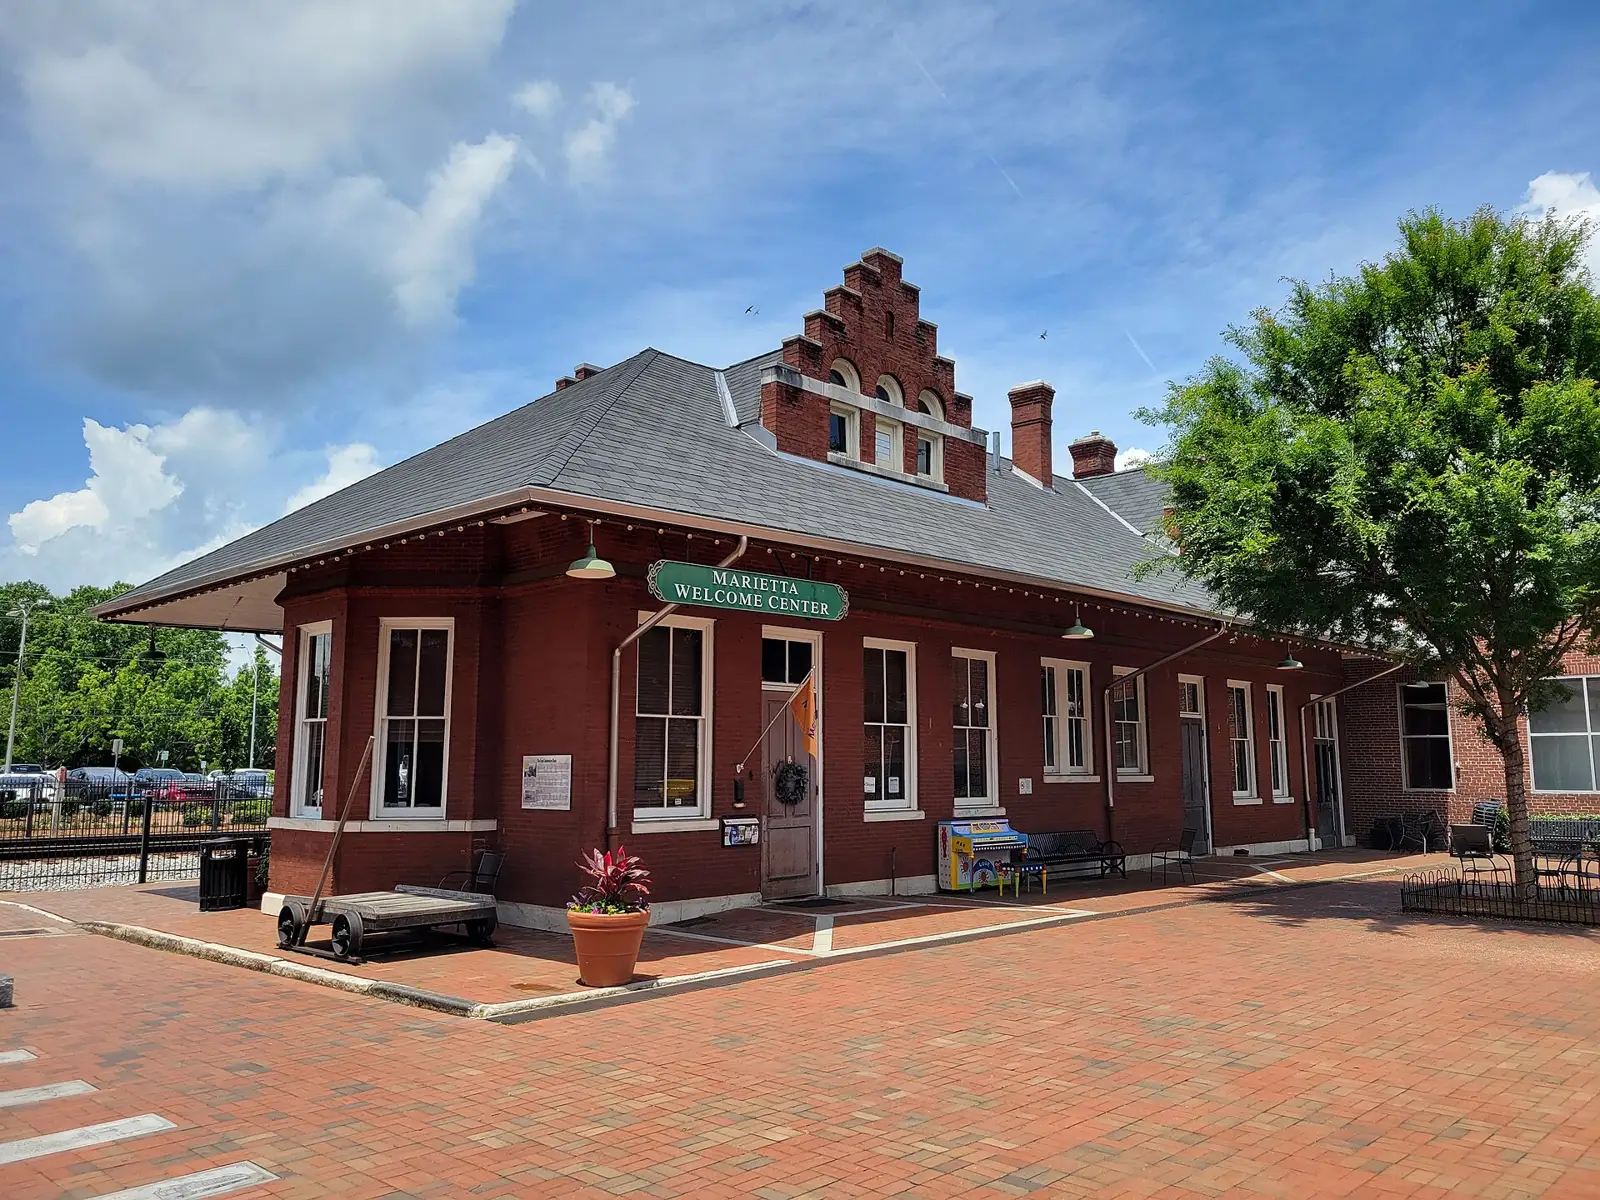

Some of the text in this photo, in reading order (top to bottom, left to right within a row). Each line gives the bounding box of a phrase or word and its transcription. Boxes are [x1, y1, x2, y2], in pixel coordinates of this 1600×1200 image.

[712, 570, 799, 595] MARIETTA
[674, 583, 829, 616] WELCOME CENTER
